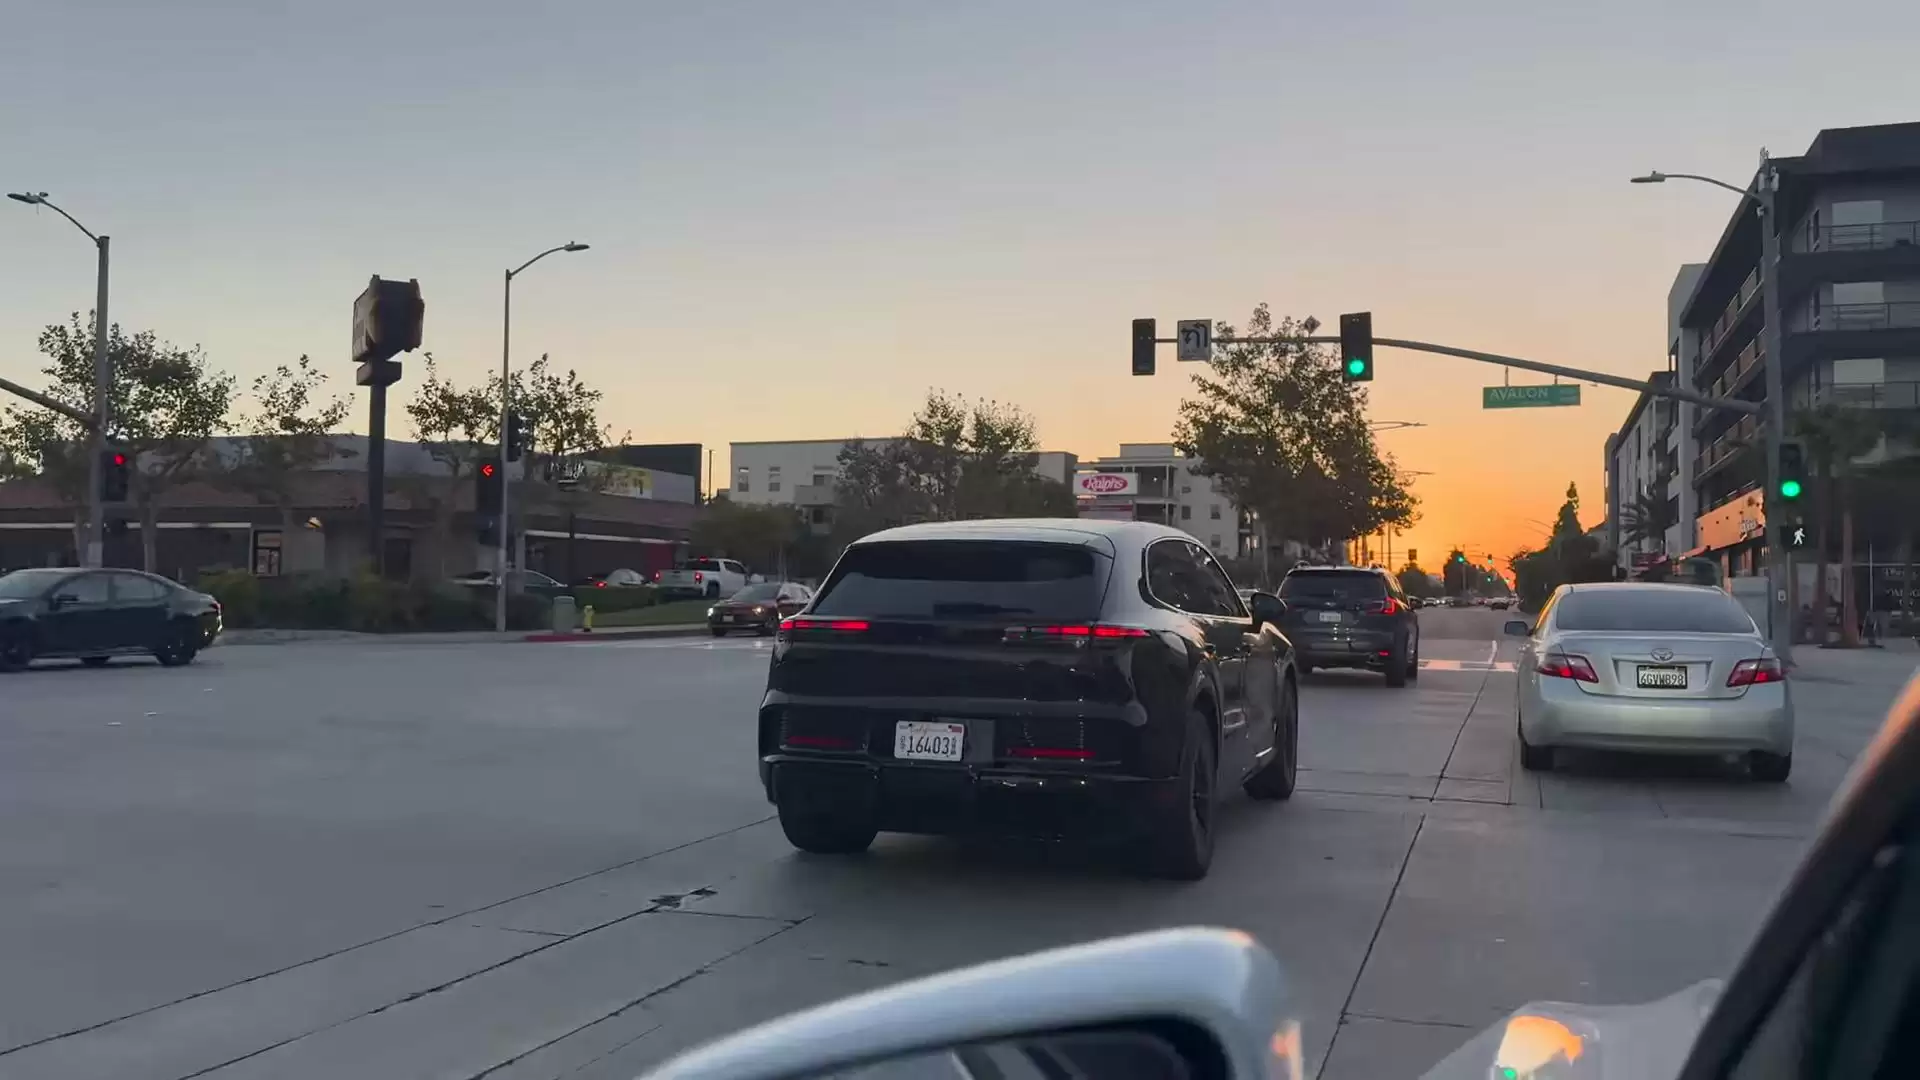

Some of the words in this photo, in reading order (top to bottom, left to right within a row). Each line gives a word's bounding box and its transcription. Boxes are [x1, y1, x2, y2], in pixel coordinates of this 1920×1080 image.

[1489, 387, 1549, 401] AVALON
[1086, 476, 1124, 492] Ralphs
[906, 735, 950, 755] 16403
